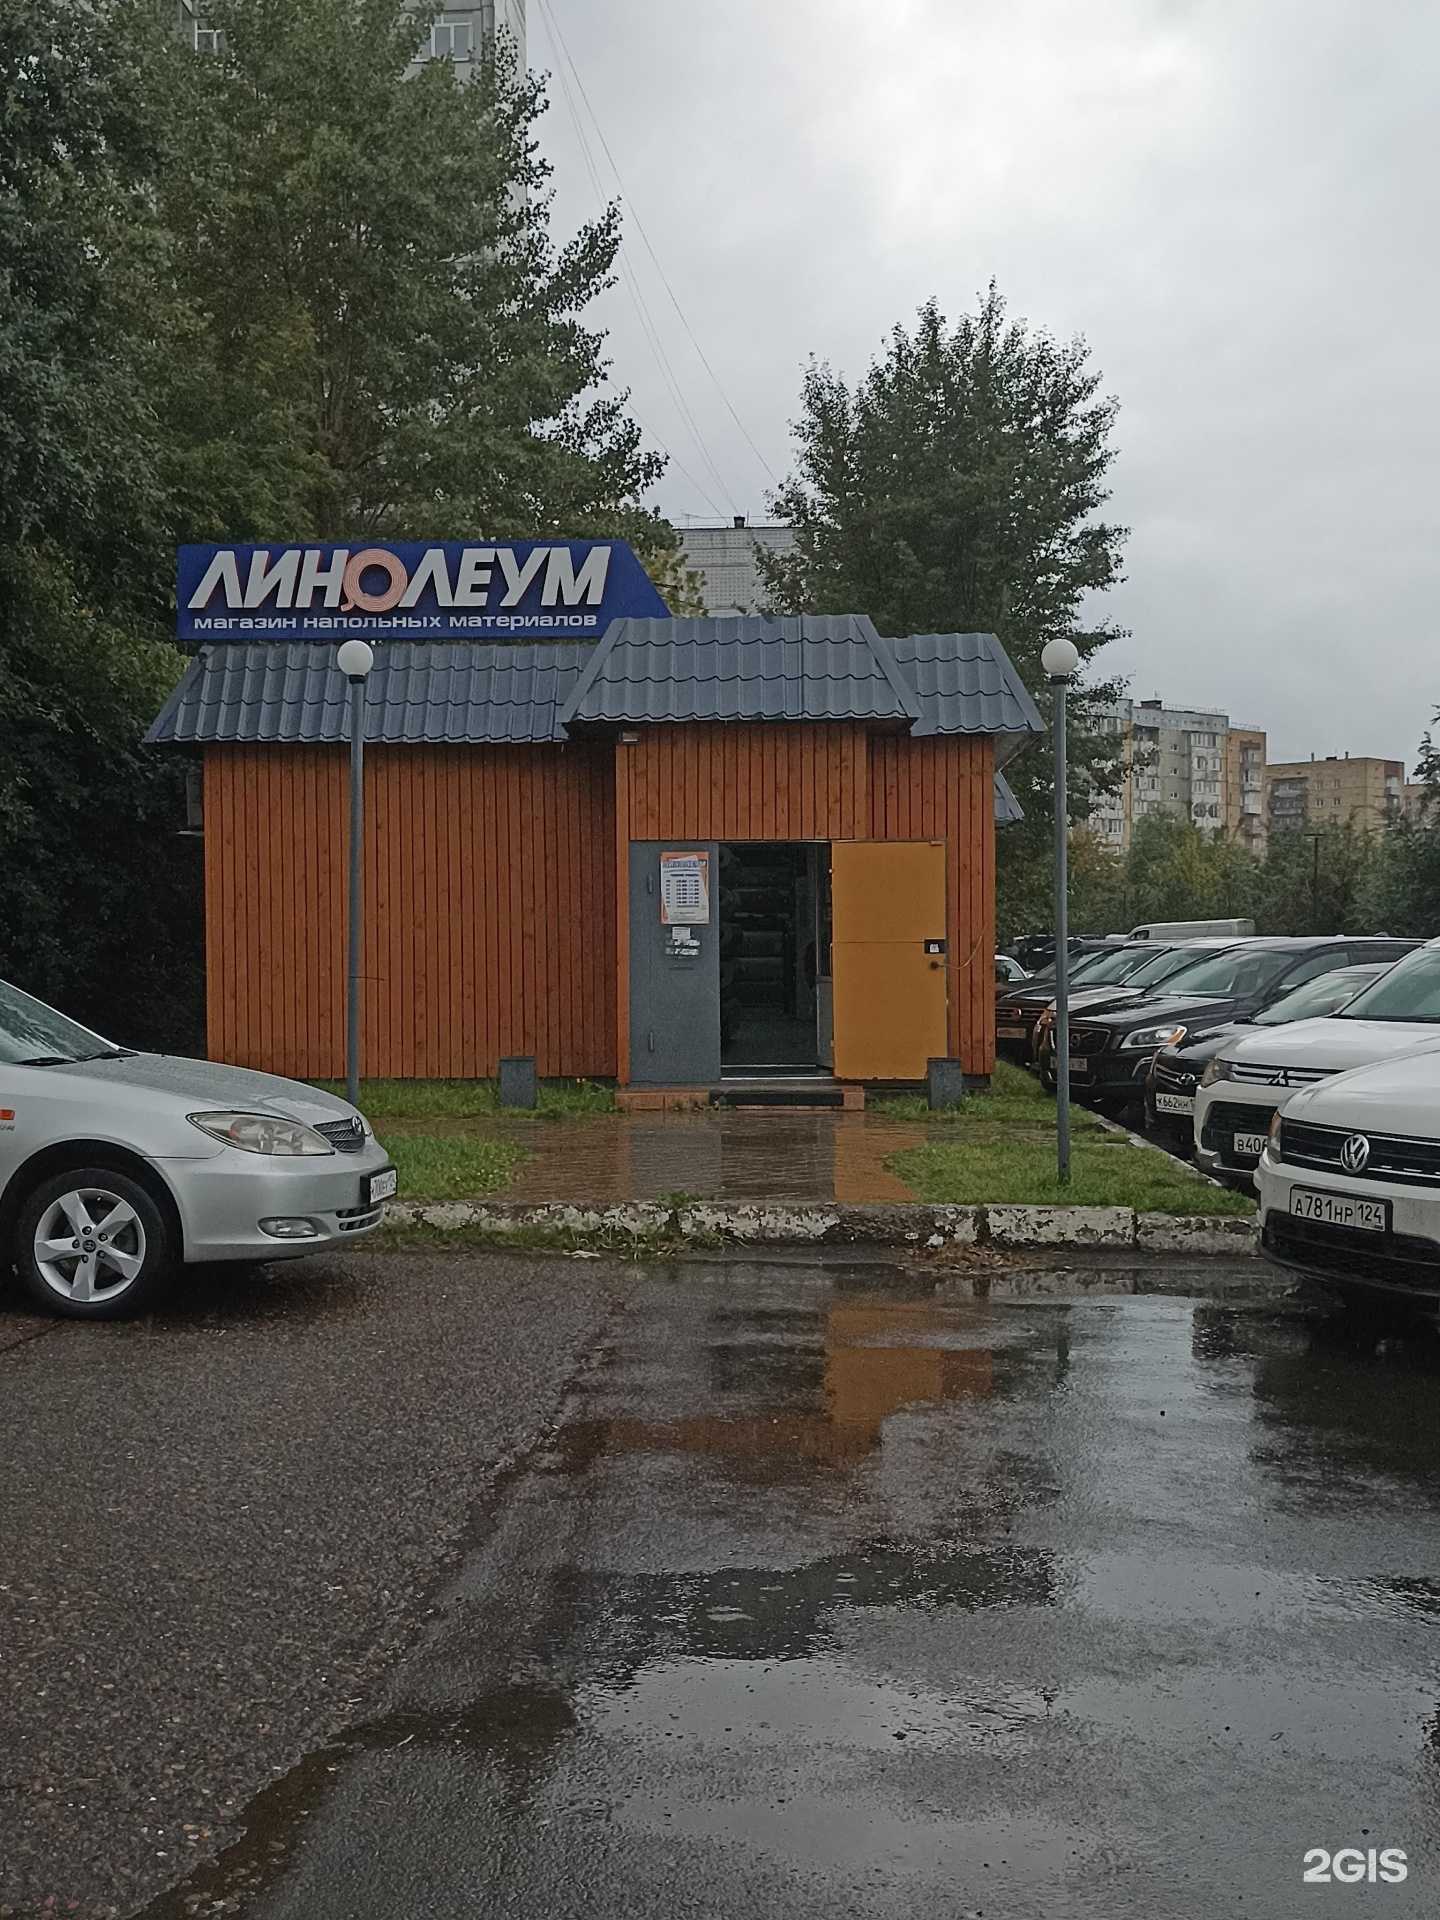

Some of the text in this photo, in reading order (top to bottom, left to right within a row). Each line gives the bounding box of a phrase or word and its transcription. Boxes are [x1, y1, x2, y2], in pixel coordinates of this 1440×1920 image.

[188, 546, 611, 612] ЛИНОЛЕУМ
[194, 614, 597, 630] магазин напольных материалов
